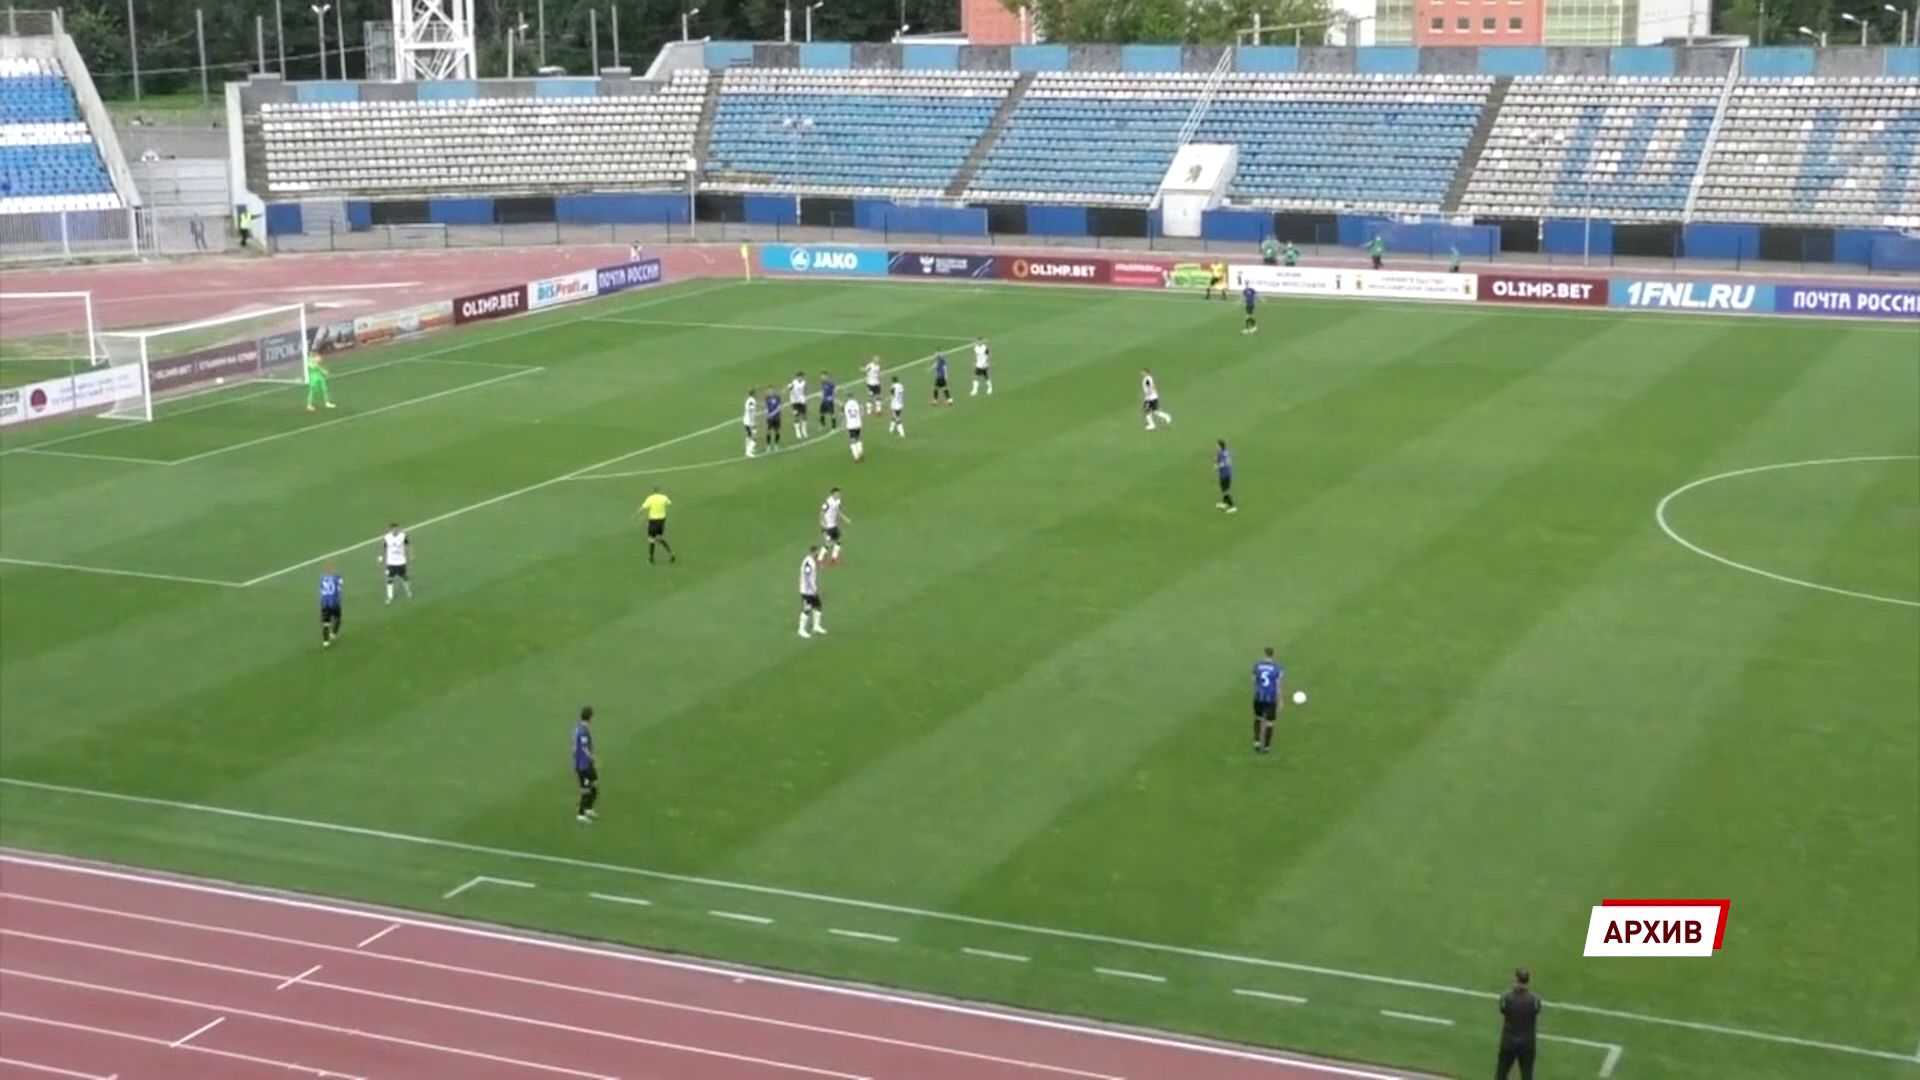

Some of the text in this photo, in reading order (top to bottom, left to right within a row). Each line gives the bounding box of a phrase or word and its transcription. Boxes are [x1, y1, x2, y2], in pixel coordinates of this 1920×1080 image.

[813, 252, 858, 270] JAKO
[1030, 263, 1096, 278] OLIMP.BET
[599, 262, 660, 289] ПОЧТА РОССИИ
[1492, 280, 1593, 299] OLIMP.BET
[1626, 281, 1756, 310] 1FNL.RU
[462, 291, 521, 317] OLIMP.BET
[1793, 290, 1851, 309] ПОЧТА
[1260, 670, 1270, 687] 5
